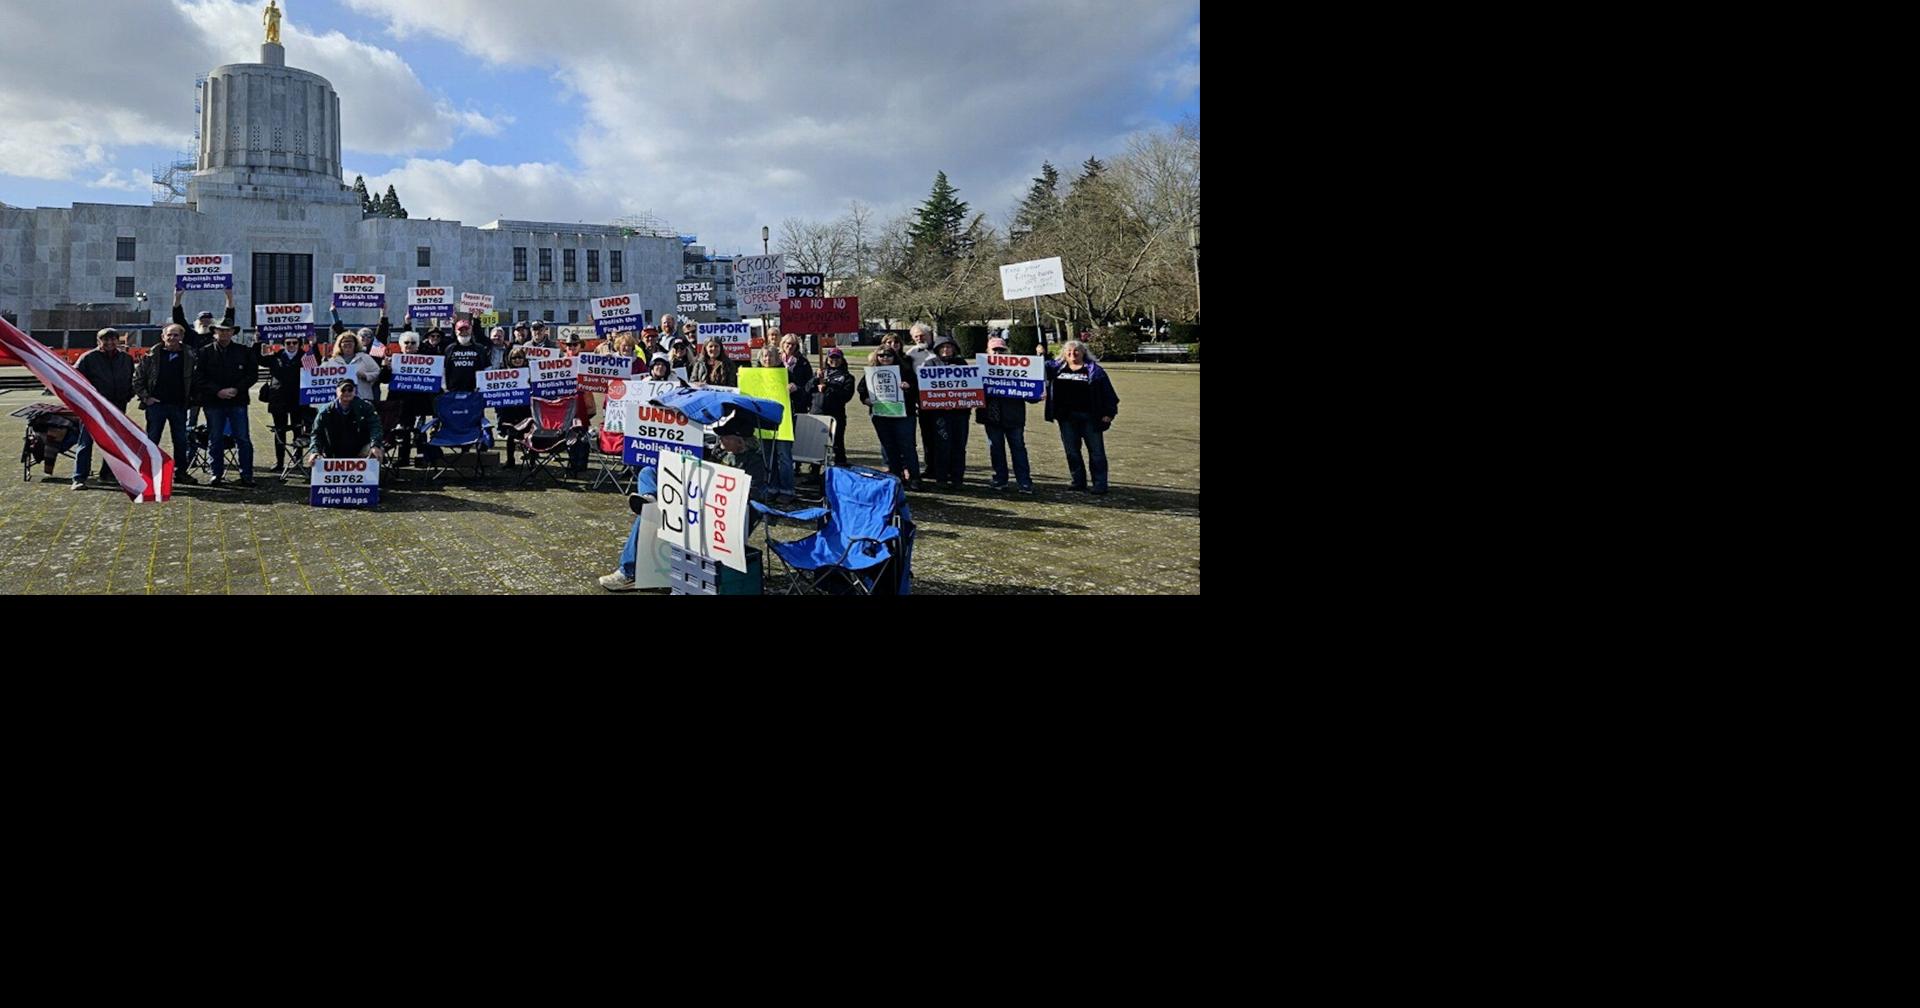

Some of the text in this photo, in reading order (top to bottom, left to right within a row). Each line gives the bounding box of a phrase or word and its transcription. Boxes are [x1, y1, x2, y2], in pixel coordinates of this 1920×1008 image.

[186, 256, 222, 265] UNDO
[737, 256, 779, 273] CROOK
[187, 266, 220, 274] SB762
[343, 275, 376, 284] UNDO
[736, 269, 782, 287] DESCHUTES
[788, 276, 820, 285] N-DO
[203, 282, 225, 290] Maps
[676, 282, 713, 292] REPEAL
[416, 288, 445, 296] UNDO
[788, 288, 796, 297] B
[599, 297, 630, 308] UNDO
[743, 292, 779, 305] OPPOSE
[676, 303, 717, 312] STOP THE
[753, 304, 770, 312] 762
[790, 298, 846, 310] NO NO NO
[266, 305, 302, 314] UNDO
[601, 307, 630, 317] SB762
[267, 315, 301, 324] SB762
[599, 318, 622, 326] Abolish
[263, 324, 292, 332] Abolish
[617, 324, 637, 332] Maps
[699, 324, 750, 334] SUPPORT
[284, 331, 306, 339] Maps
[527, 347, 551, 357] NDO
[401, 355, 434, 365] UNDO
[538, 359, 572, 370] UNDO
[580, 354, 631, 368] SUPPORT
[987, 356, 1031, 367] UNDO
[311, 366, 347, 377] UNDO
[400, 366, 431, 375] SB762
[540, 370, 571, 379] SB762
[587, 366, 619, 376] SB678
[920, 367, 979, 379] SUPPORT
[988, 368, 1028, 378] SB762
[394, 375, 422, 383] Abolish
[485, 370, 520, 381] UNDO
[486, 381, 518, 390] SB762
[537, 380, 565, 389] Abolish
[931, 380, 968, 389] SB678
[983, 378, 1036, 388] Abolish the
[306, 387, 336, 396] Abolish
[557, 388, 577, 396] Maps
[579, 384, 606, 392] Property
[987, 387, 1034, 397] Fire Maps
[483, 391, 511, 399] Abolish
[927, 391, 977, 399] Save Oregon
[922, 399, 984, 408] Property Rights
[639, 406, 689, 426] UNDO
[638, 425, 684, 442] SB762
[631, 439, 693, 456] Abolish the
[636, 453, 657, 464] Fire
[324, 460, 367, 472] UNDO
[324, 475, 364, 483] SB762
[342, 497, 368, 506] Maps
[661, 467, 683, 533] 762
[705, 473, 736, 554] Repeal
